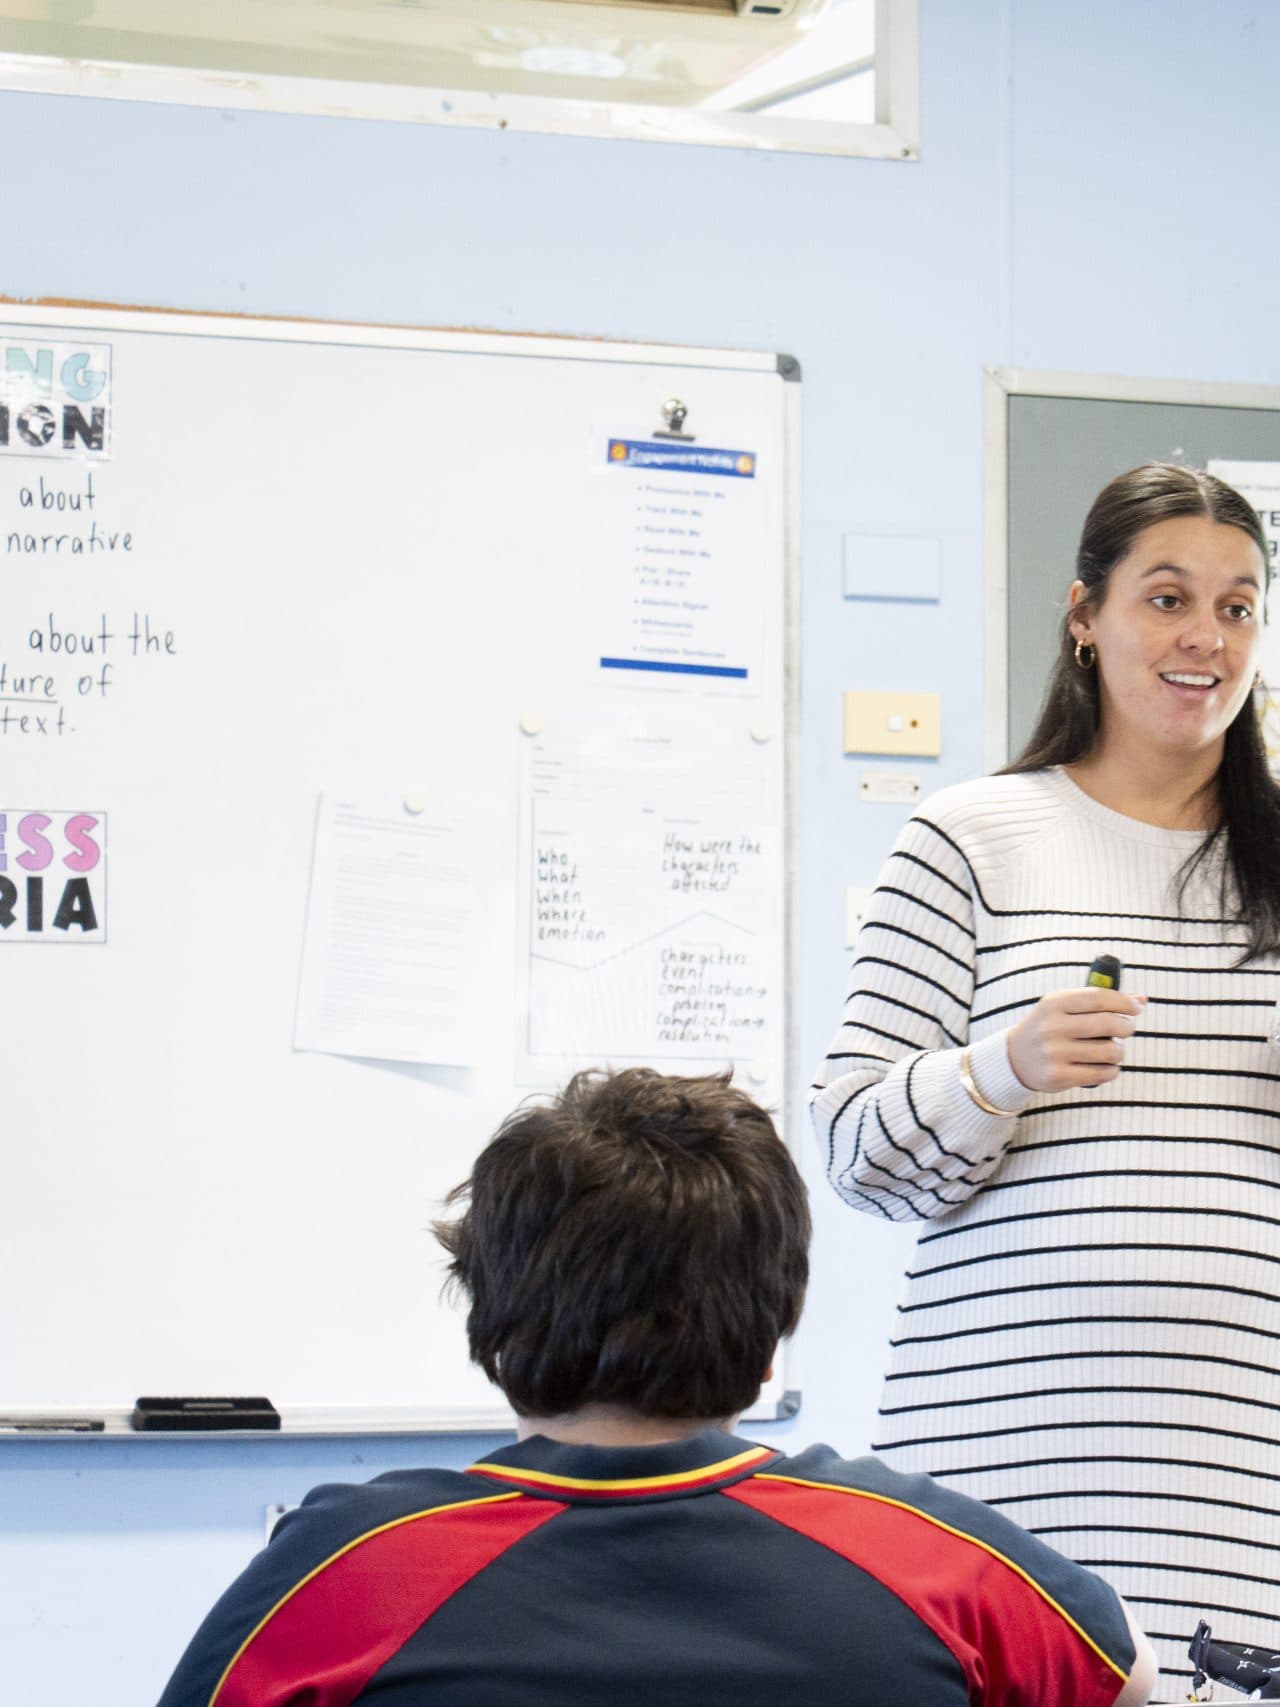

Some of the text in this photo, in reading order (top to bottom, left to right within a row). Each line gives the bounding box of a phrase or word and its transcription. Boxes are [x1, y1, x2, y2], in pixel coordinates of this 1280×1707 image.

[19, 472, 96, 511] about
[7, 520, 133, 555] narrative
[30, 611, 177, 656] about the
[78, 663, 114, 697] of
[0, 813, 100, 873] SS
[538, 923, 606, 942] emotion
